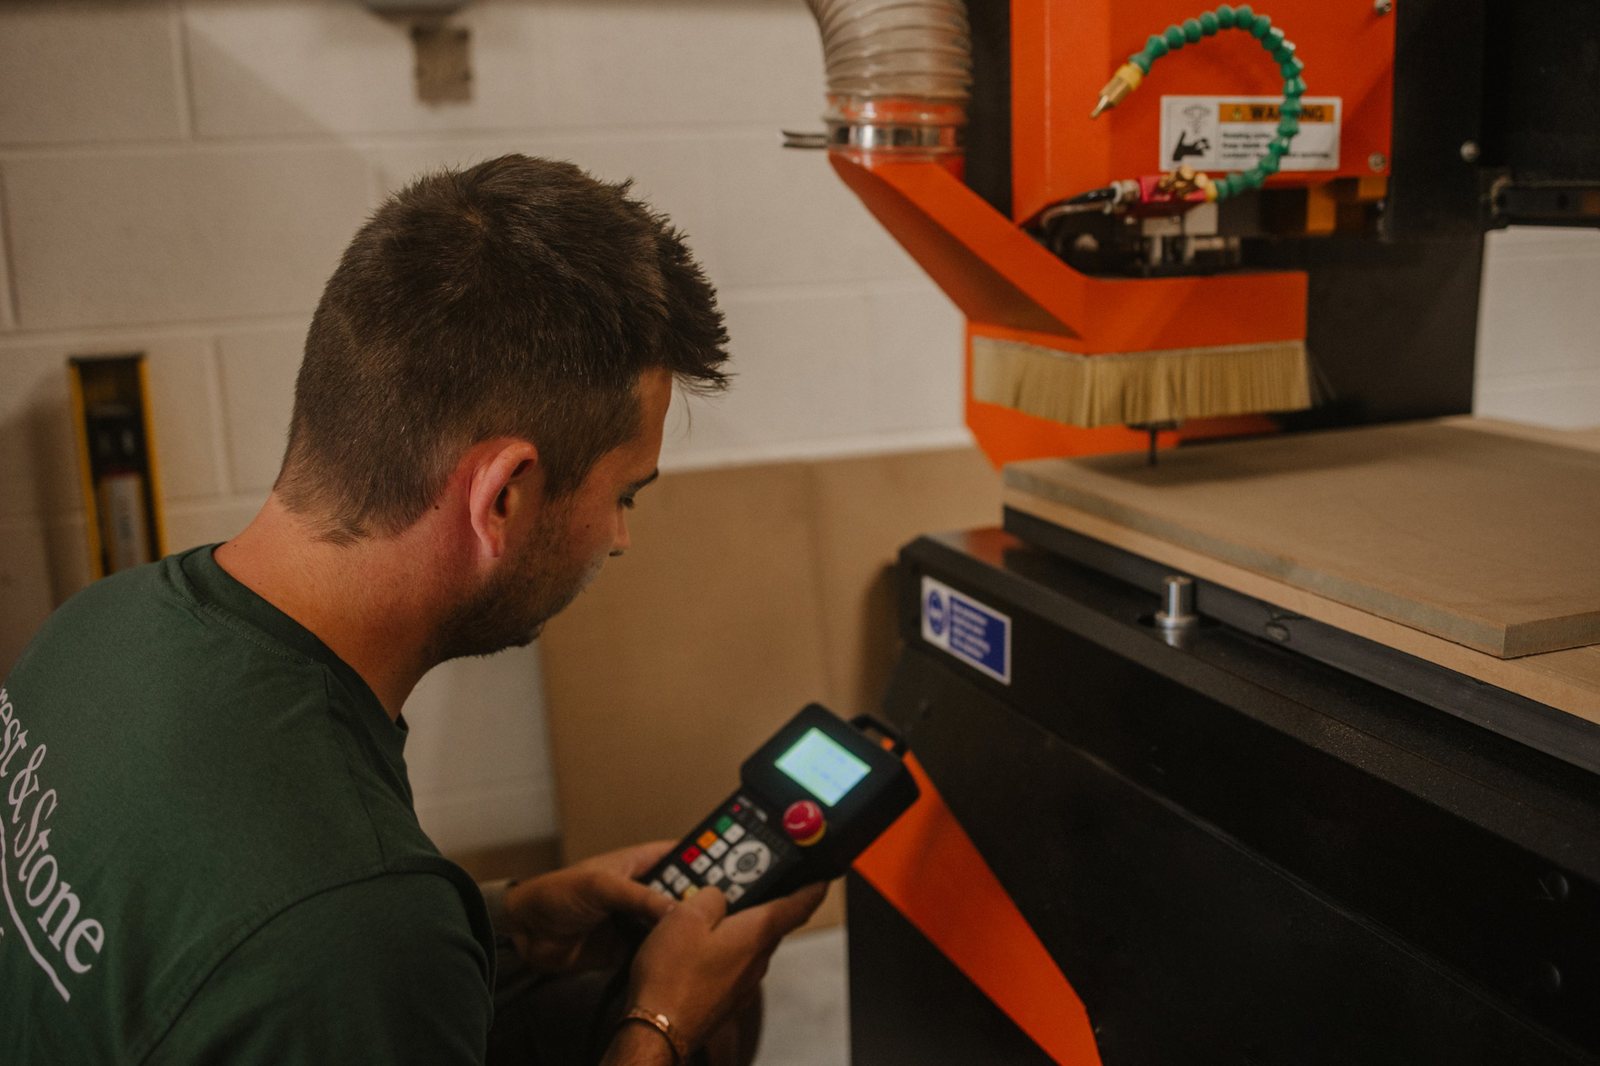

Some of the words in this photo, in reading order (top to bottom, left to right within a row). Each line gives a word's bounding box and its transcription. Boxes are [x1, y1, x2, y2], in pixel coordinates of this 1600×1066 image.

[1249, 105, 1325, 121] WAING
[9, 744, 46, 823] &
[14, 789, 104, 974] Stone
